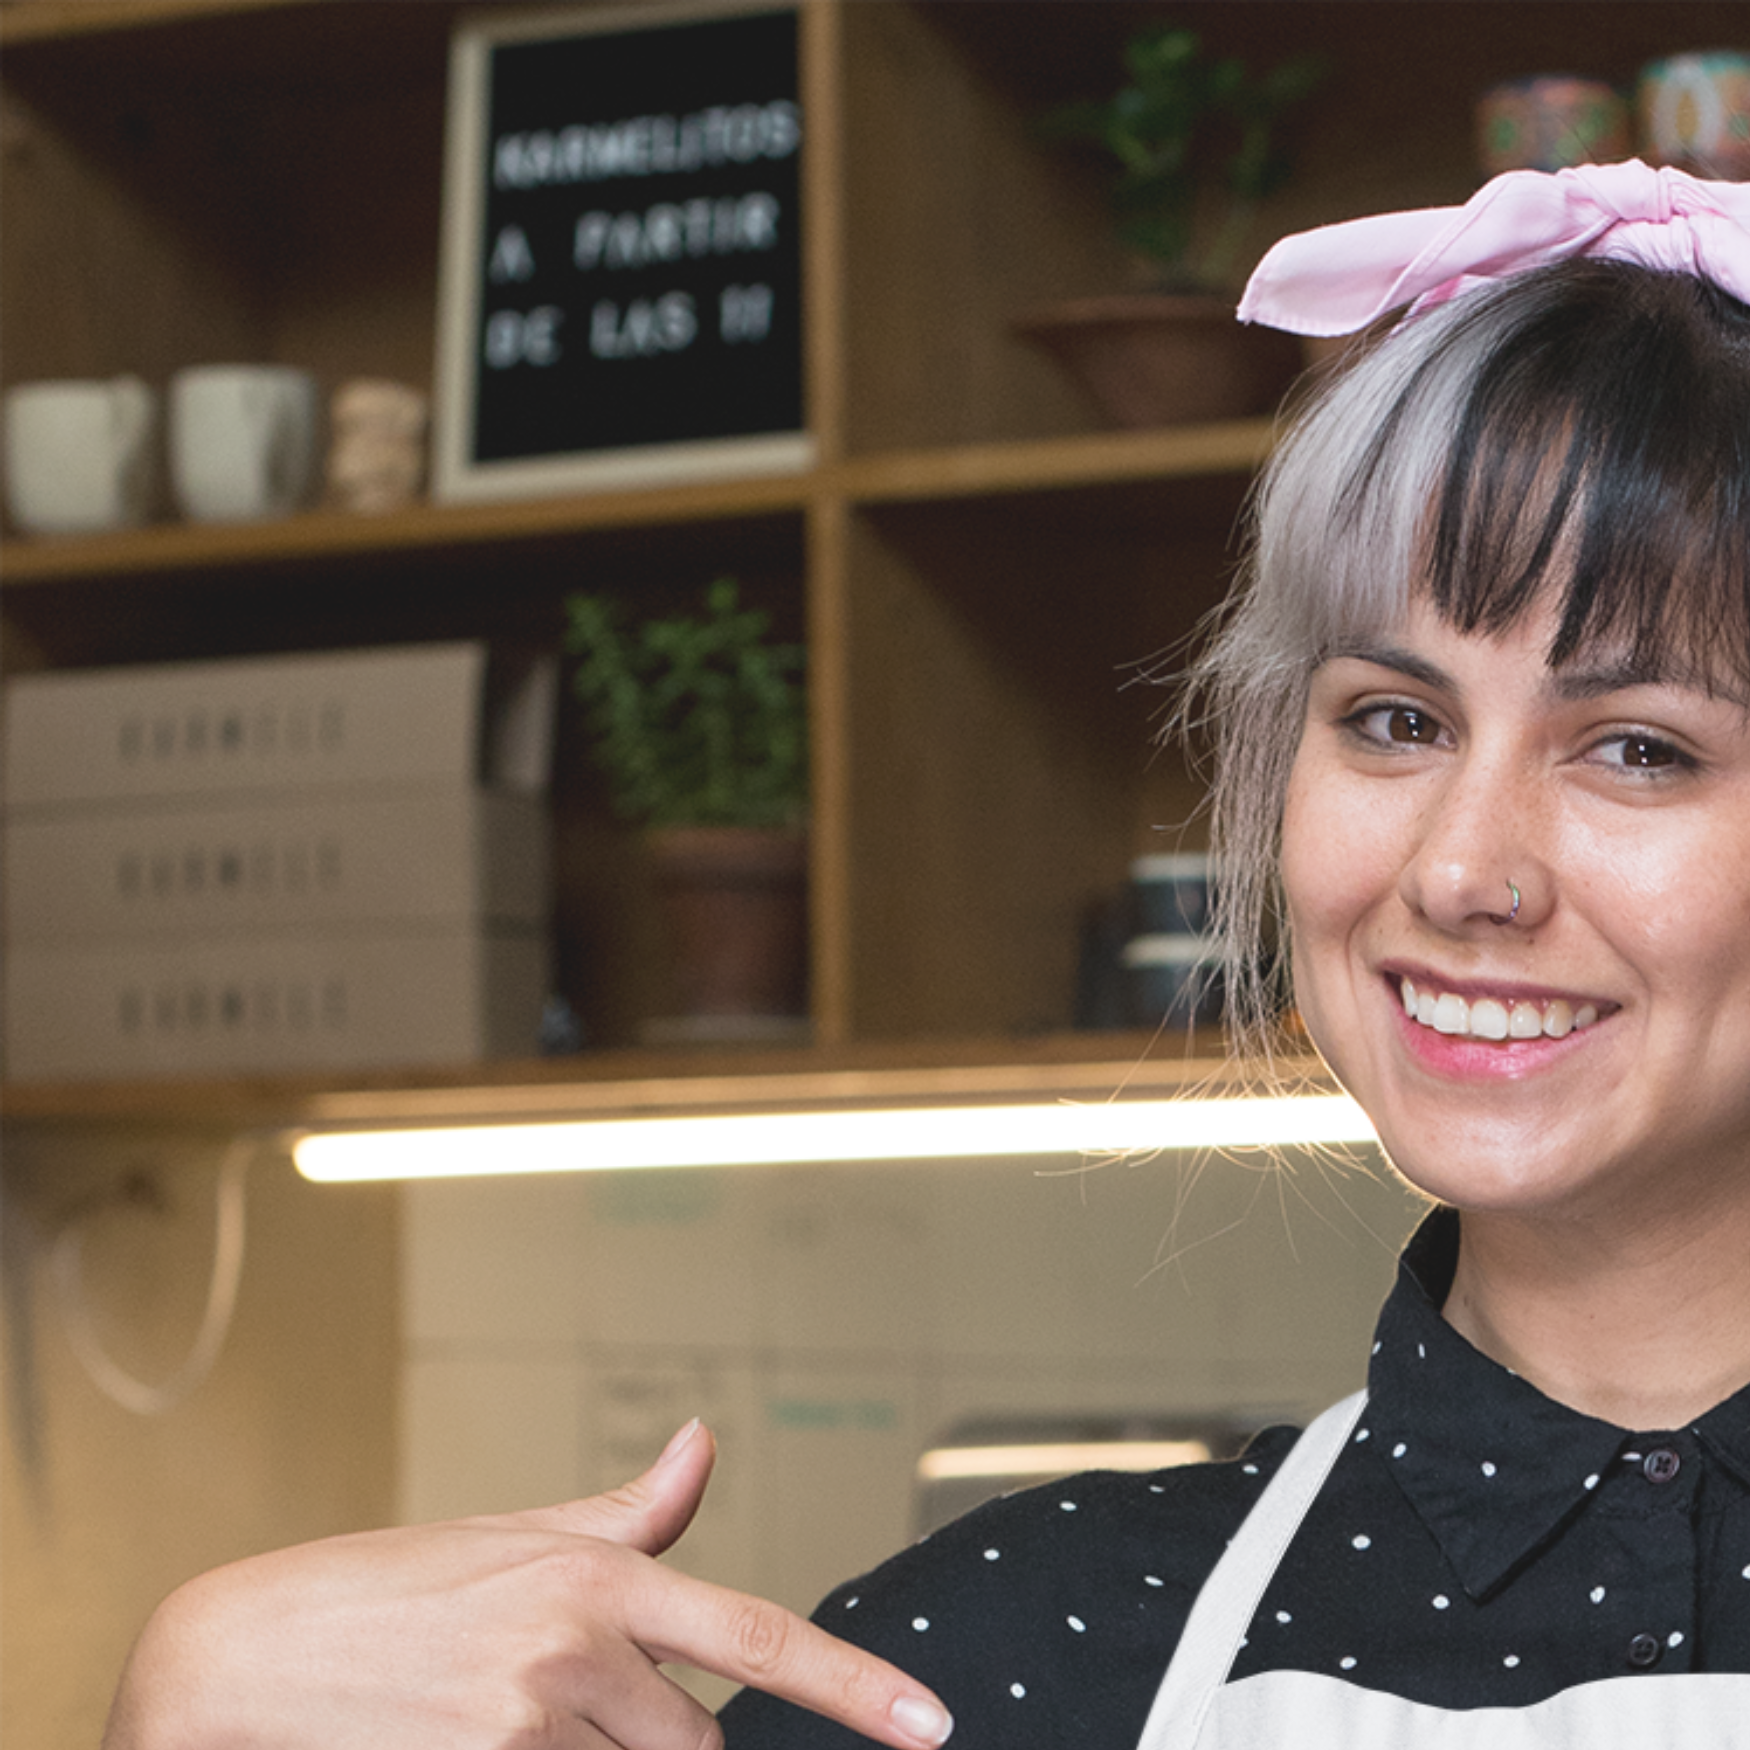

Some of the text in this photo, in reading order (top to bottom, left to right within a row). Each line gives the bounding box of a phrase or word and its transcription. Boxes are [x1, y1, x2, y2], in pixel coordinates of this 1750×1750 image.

[494, 100, 801, 190] KARMELITOS
[489, 192, 780, 281] A PARTIR
[485, 304, 562, 368] DE
[590, 290, 698, 358] LAS
